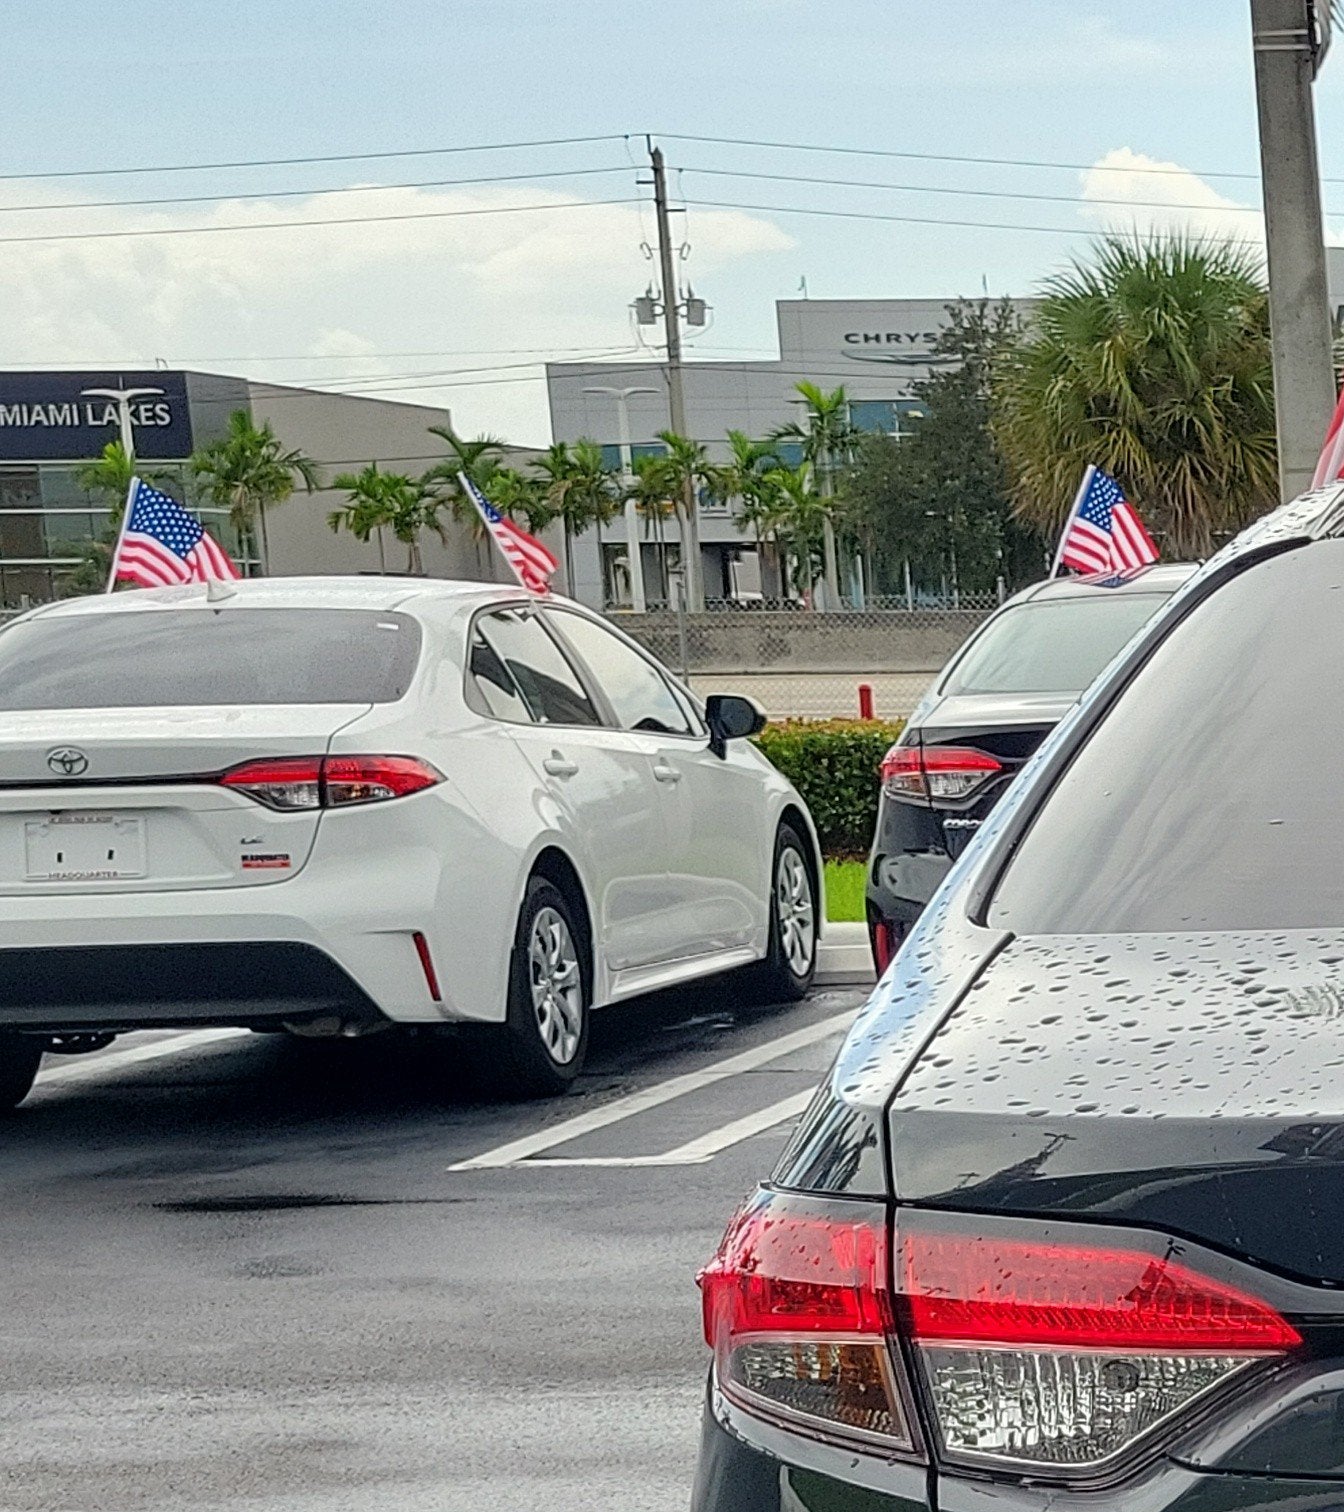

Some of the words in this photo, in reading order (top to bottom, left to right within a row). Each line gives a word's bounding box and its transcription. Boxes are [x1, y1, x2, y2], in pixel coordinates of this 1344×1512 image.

[844, 332, 940, 344] CHRYS
[0, 403, 79, 427] MIAMI
[87, 403, 171, 427] LAKES
